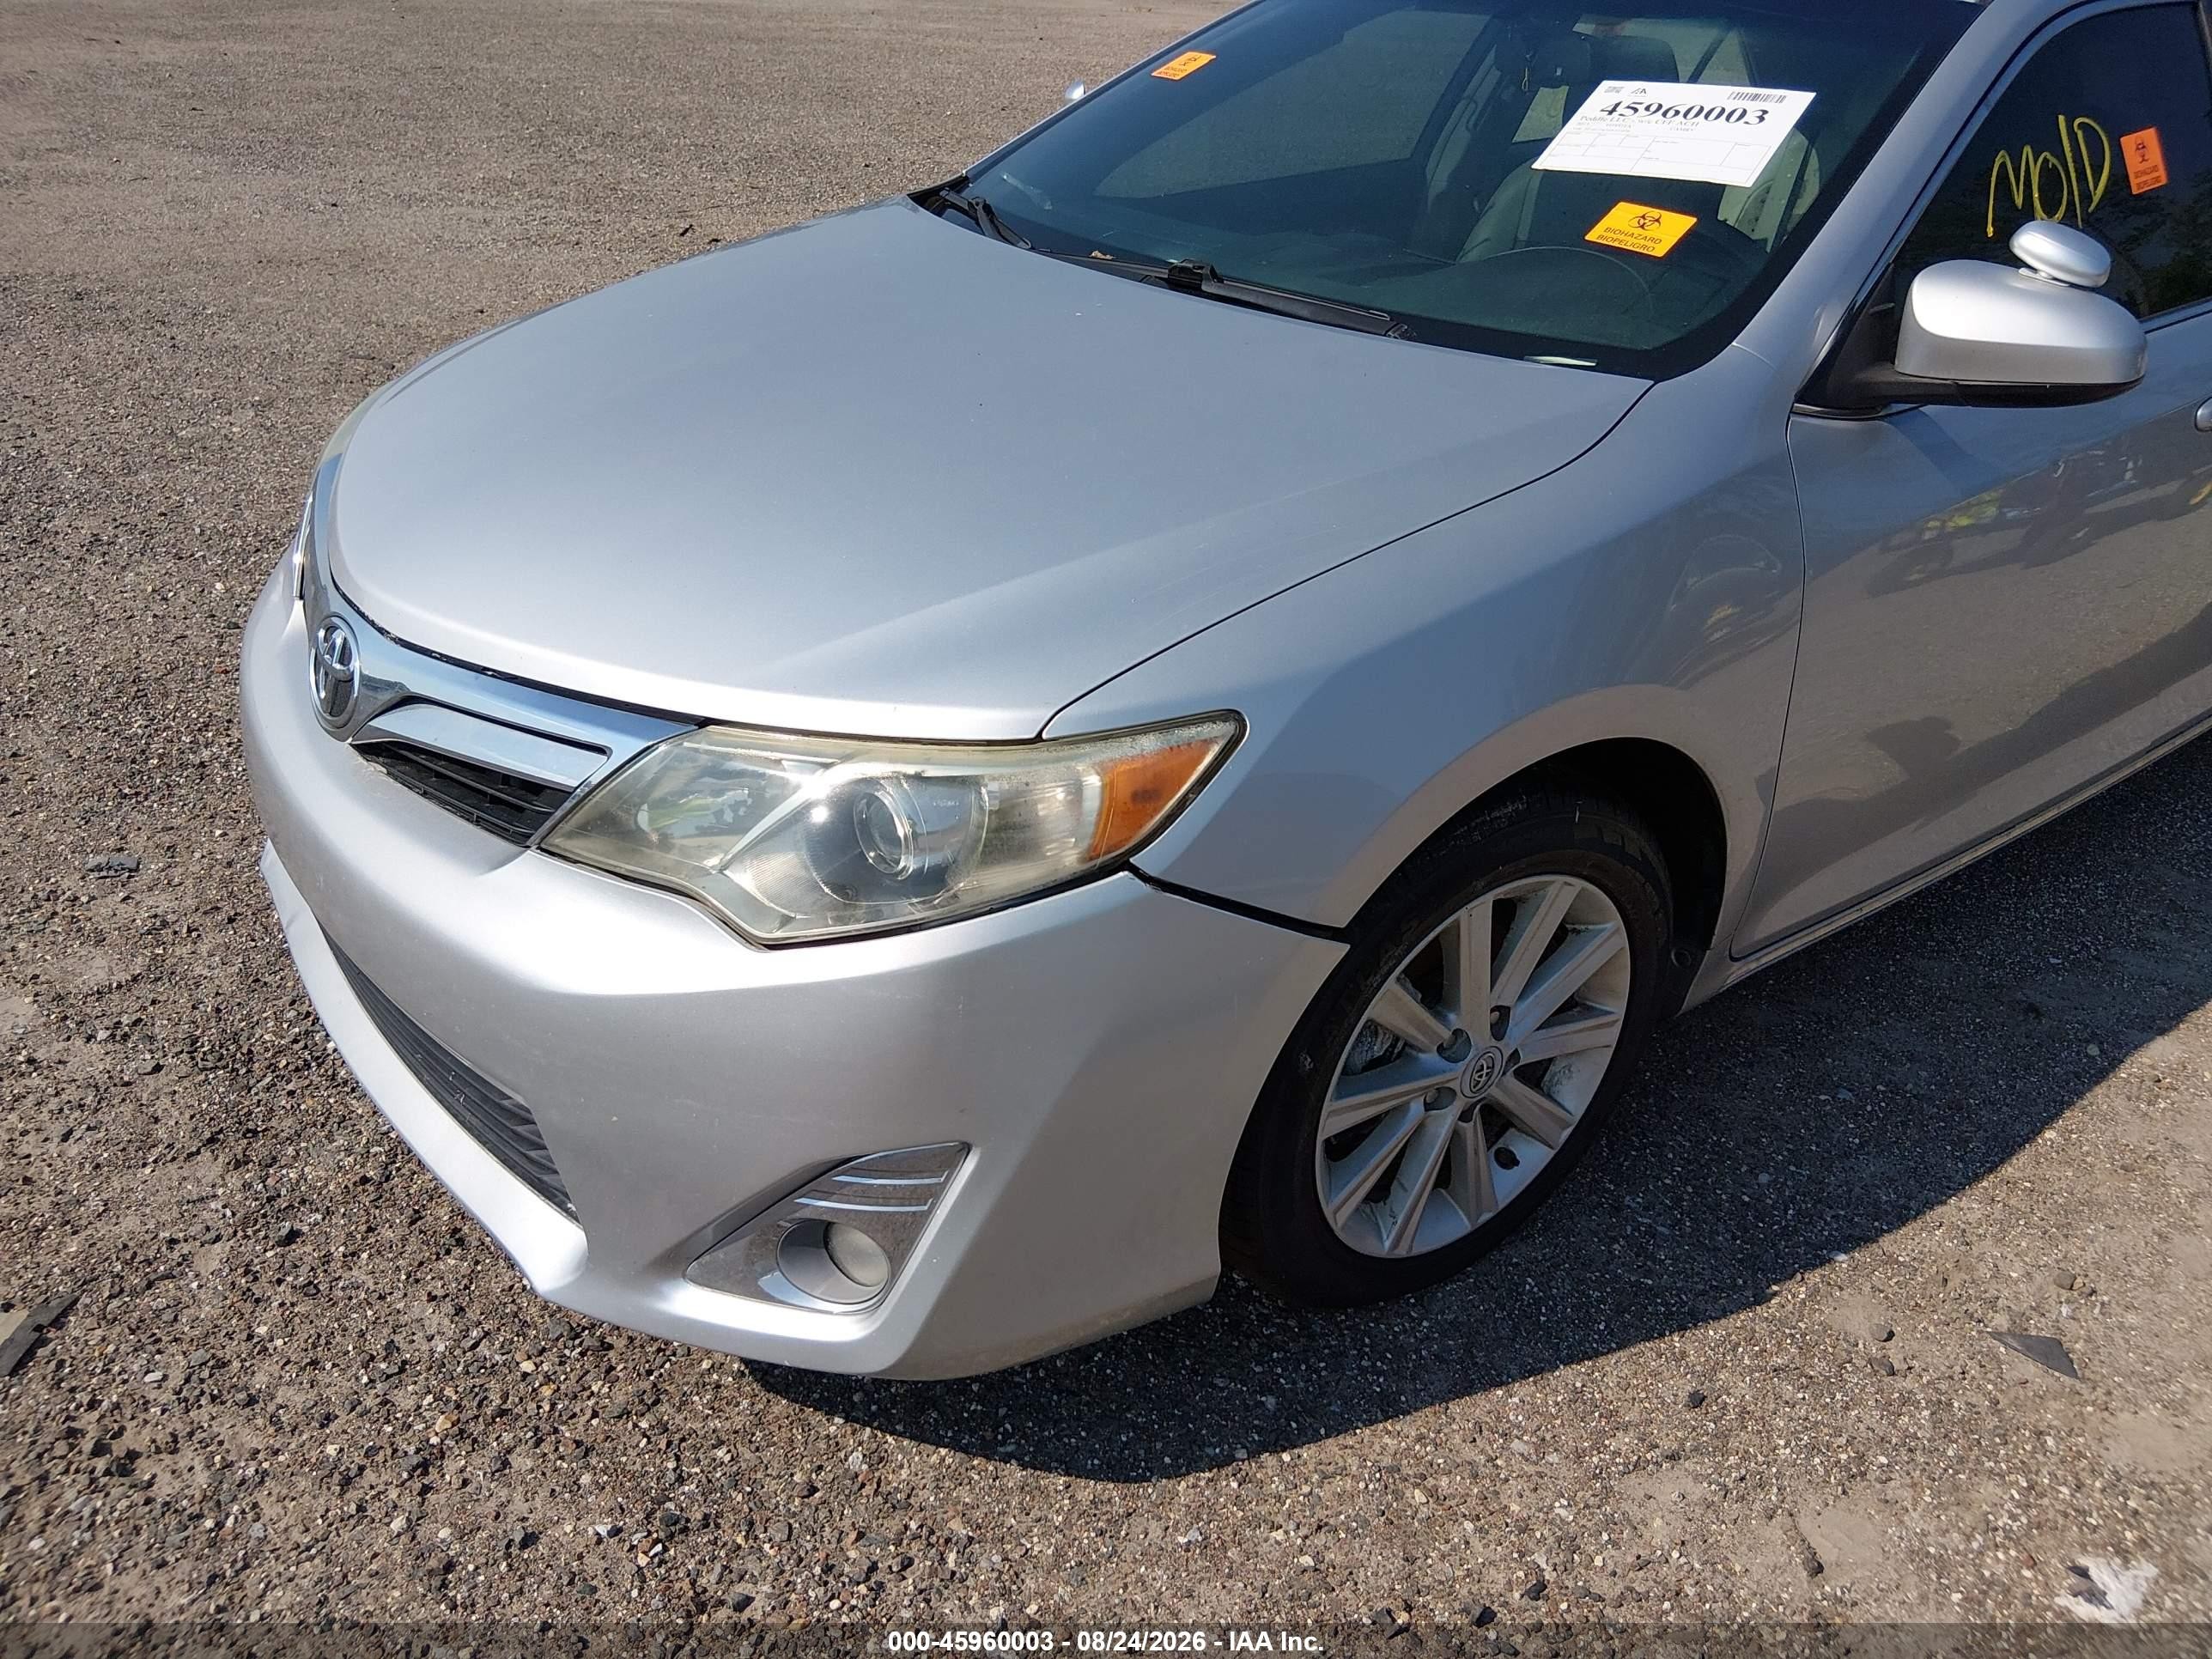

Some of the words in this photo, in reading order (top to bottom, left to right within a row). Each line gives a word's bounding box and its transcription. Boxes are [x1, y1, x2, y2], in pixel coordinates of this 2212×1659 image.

[1600, 100, 1769, 125] 45960003
[1596, 234, 1656, 252] BIOPELIGRO
[1603, 227, 1662, 245] BIOHAZARD
